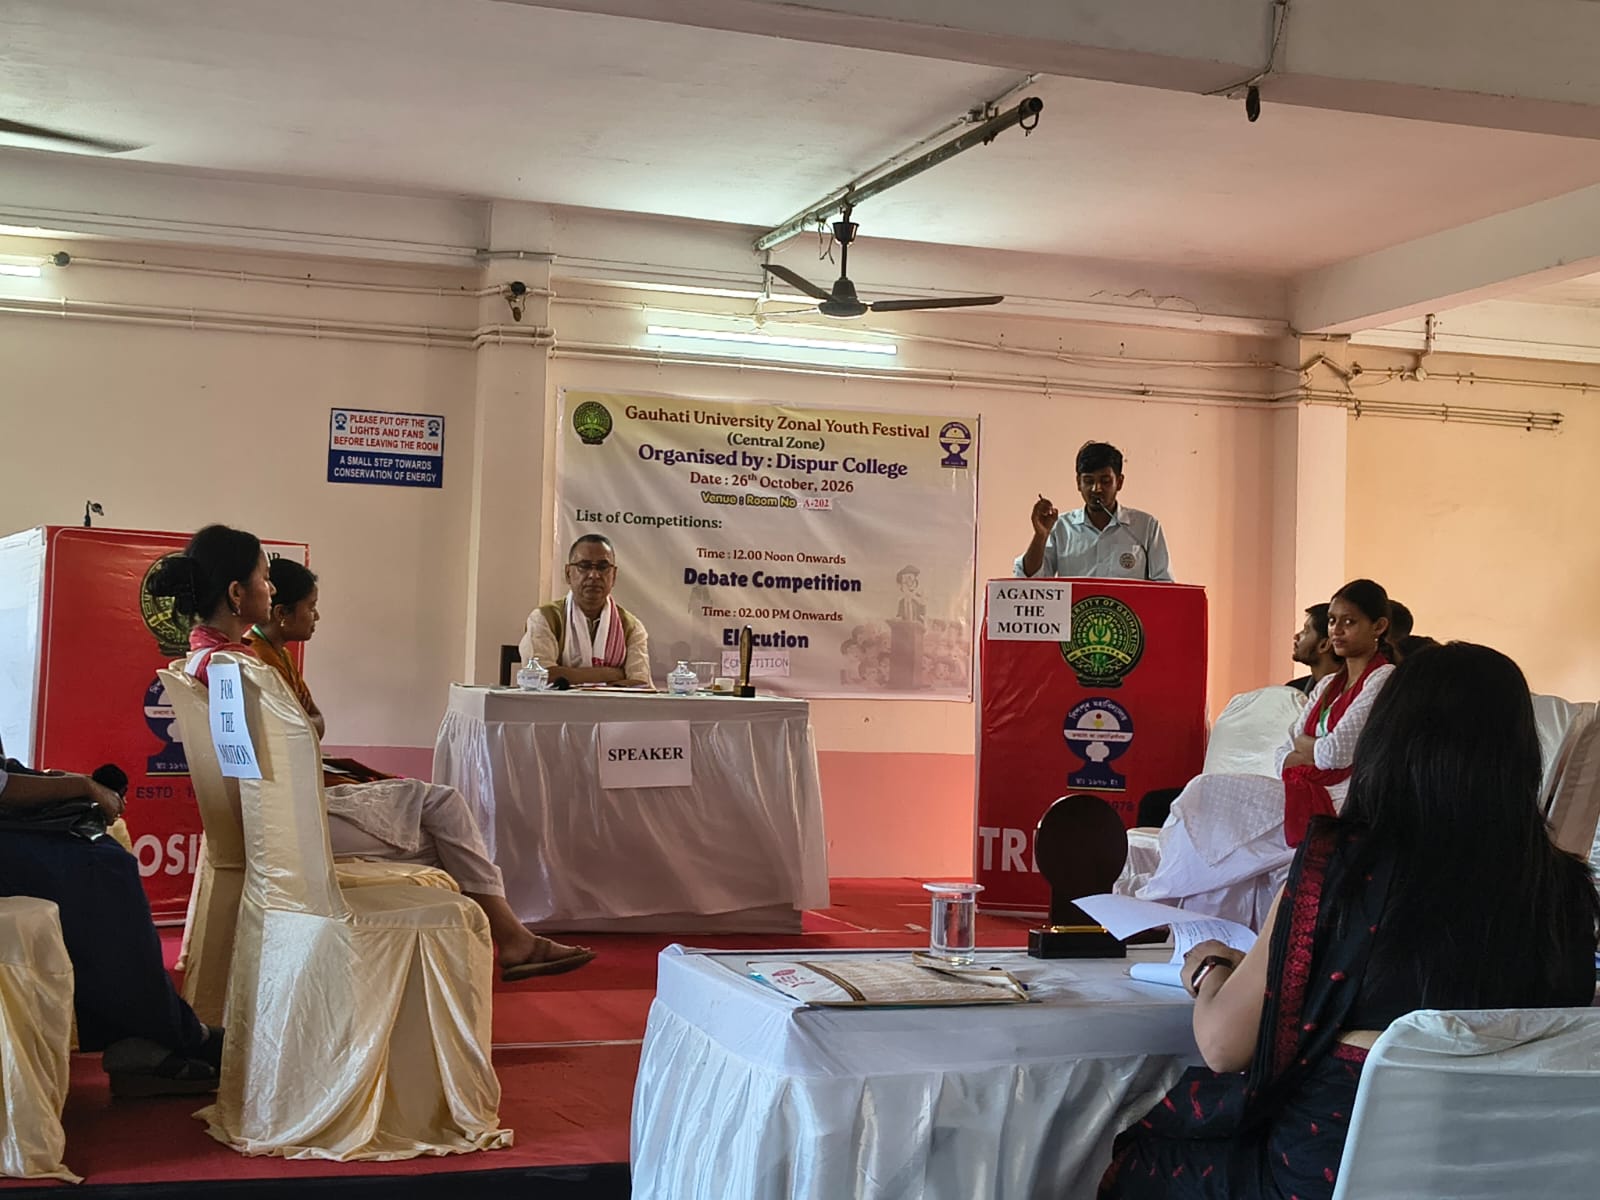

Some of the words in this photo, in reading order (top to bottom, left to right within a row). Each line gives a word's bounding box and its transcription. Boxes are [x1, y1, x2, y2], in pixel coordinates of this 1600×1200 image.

[350, 414, 378, 425] PLEASE
[380, 417, 393, 425] PUT
[395, 418, 410, 427] OFF
[411, 418, 425, 428] THE
[625, 405, 690, 423] Gauhati
[694, 411, 774, 431] University
[777, 416, 821, 432] Zonal
[825, 419, 869, 435] Youth
[872, 422, 930, 438] Festival
[350, 427, 380, 436] LIGHTS
[382, 428, 400, 437] AND
[402, 430, 424, 439] FANS
[727, 432, 783, 447] (Central
[787, 437, 825, 451] Zone)
[334, 436, 364, 446] BEFORE
[366, 438, 398, 449] LEAVING
[400, 440, 415, 449] THE
[416, 442, 439, 451] ROOM
[340, 456, 346, 465] A
[347, 456, 372, 467] SMALL
[374, 458, 393, 468] STEP
[395, 459, 432, 470] TOWARDS
[639, 444, 737, 465] Organised
[776, 453, 839, 474] Dispur
[842, 457, 908, 479] College
[334, 467, 392, 480] CONSERVATION
[394, 471, 405, 480] OF
[406, 472, 436, 483] ENERGY
[690, 471, 722, 485] Date
[759, 476, 818, 492] October,
[820, 479, 854, 493] 2026
[701, 491, 737, 505] Venue
[745, 493, 779, 508] Room
[779, 495, 798, 509] No
[803, 499, 829, 508] A-202
[576, 509, 602, 522] List
[605, 512, 620, 523] of
[622, 512, 723, 529] Competitions:
[696, 547, 726, 559] Time
[733, 549, 762, 561] 12.00
[764, 551, 794, 562] Noon
[796, 552, 847, 565] Onwards
[684, 567, 748, 588] Debate
[752, 571, 862, 593] Competition
[996, 588, 1064, 601] AGAINST
[702, 606, 731, 617] Time
[738, 608, 770, 619] 02.00
[772, 609, 790, 620] PM
[793, 609, 843, 622] Onwards
[1014, 605, 1045, 617] THE
[997, 622, 1061, 634] MOTION
[723, 628, 809, 648] Elcution
[220, 679, 234, 700] FOR
[220, 711, 235, 733] THE
[218, 744, 252, 765] MOTION
[608, 747, 684, 761] SPEAKER
[136, 786, 173, 799] ESTD
